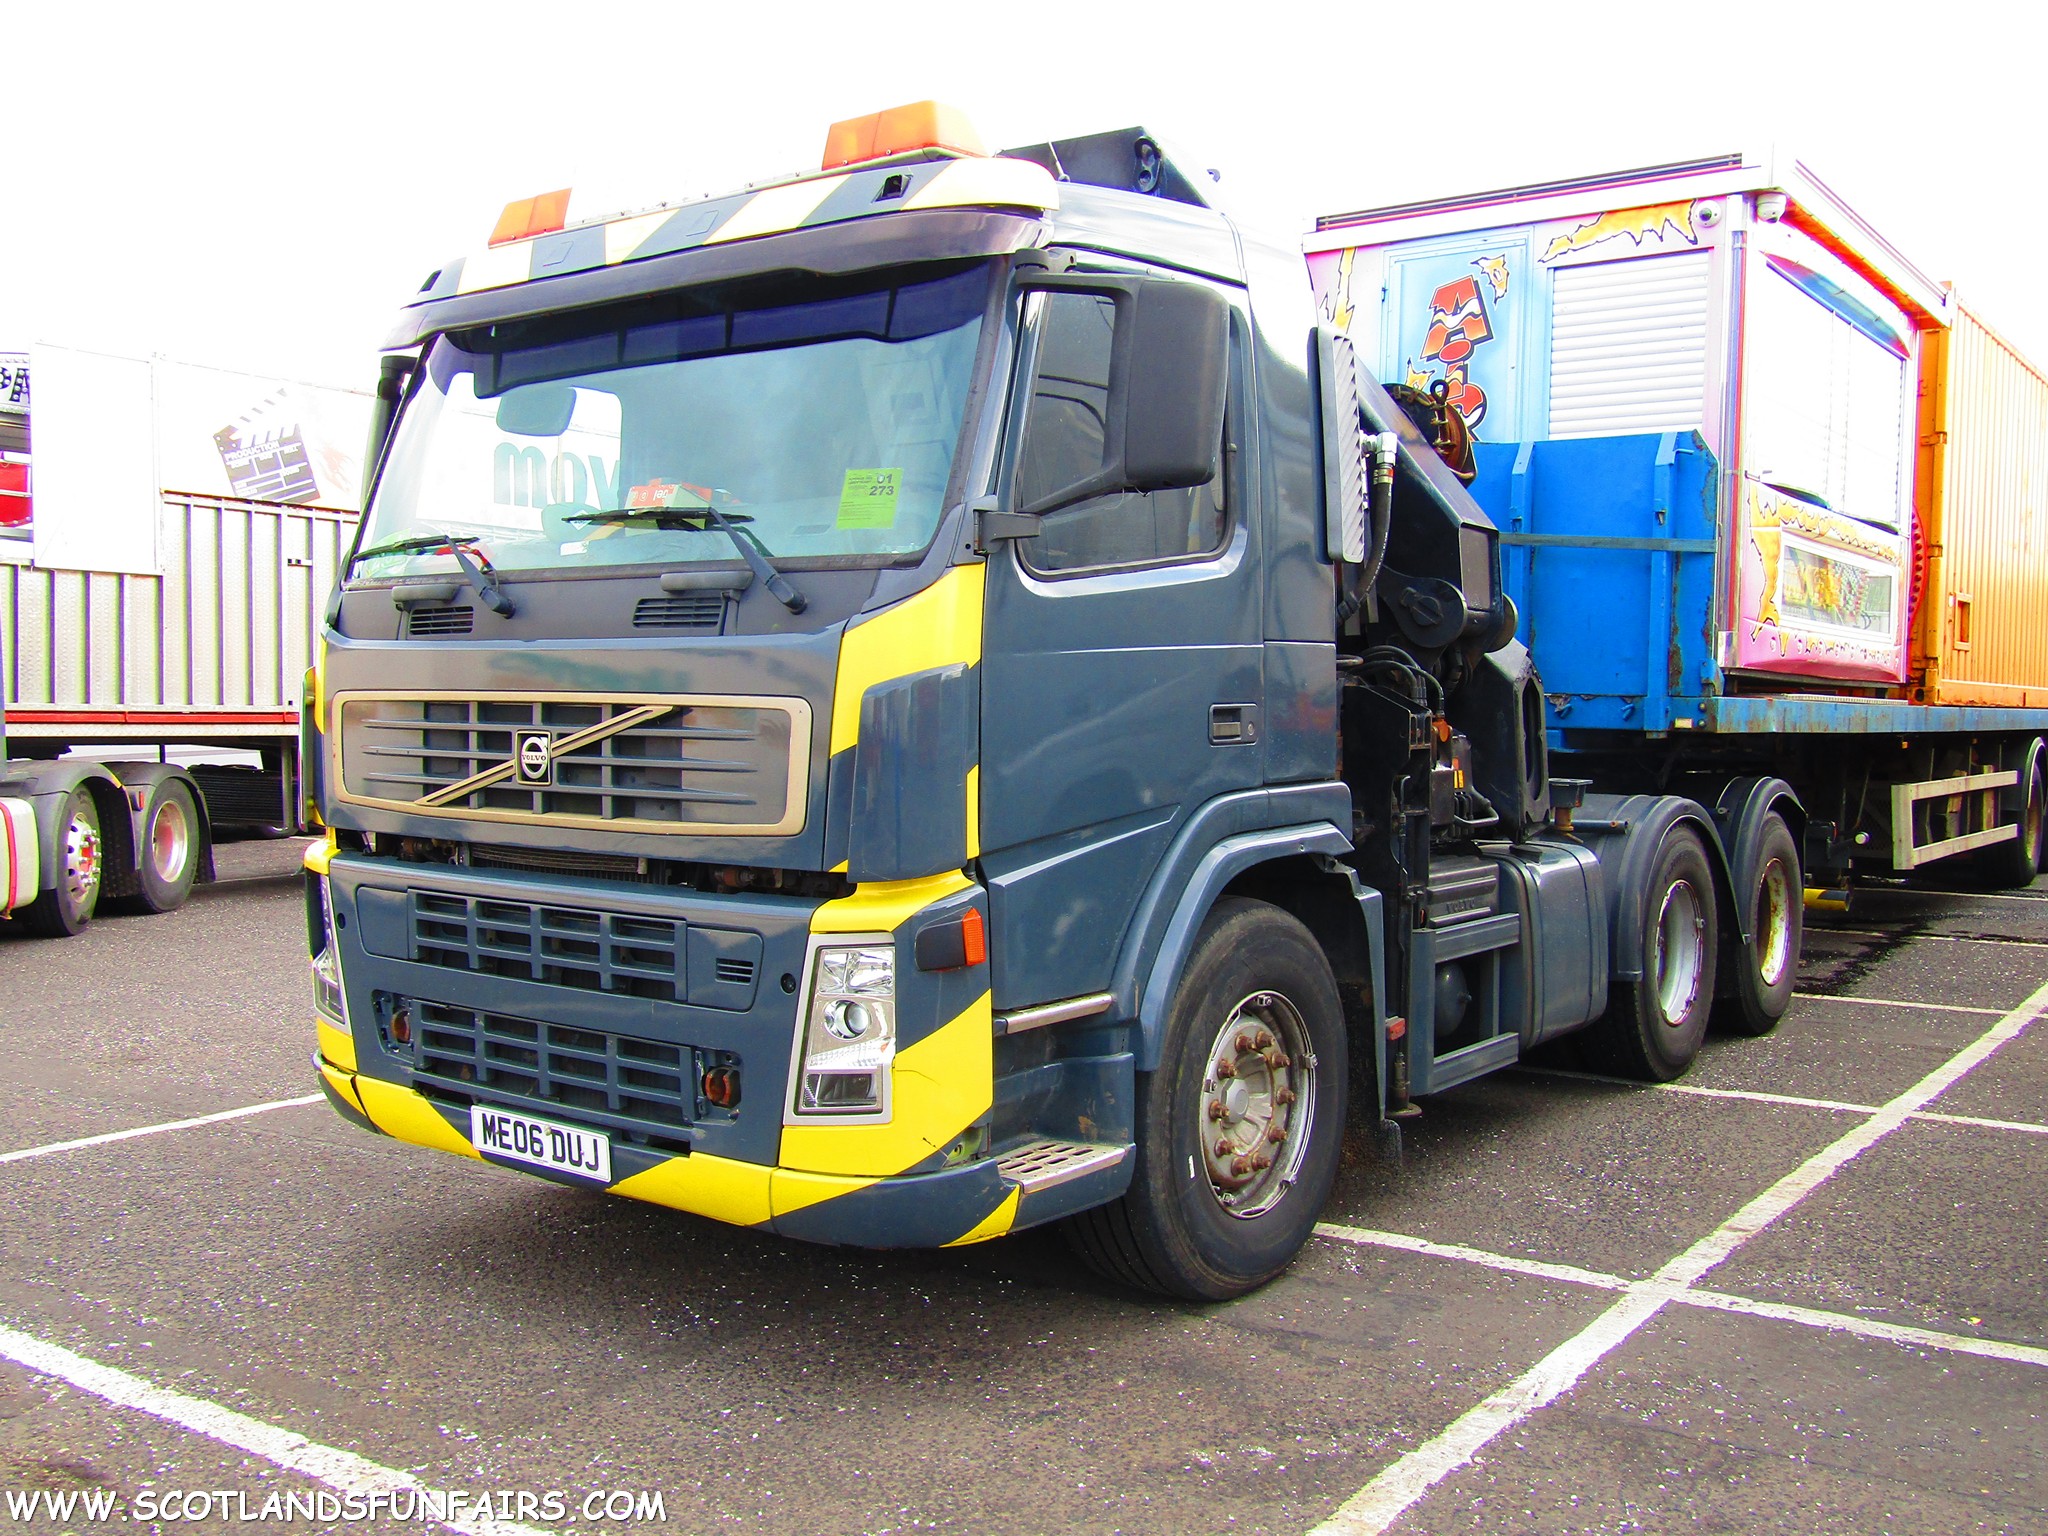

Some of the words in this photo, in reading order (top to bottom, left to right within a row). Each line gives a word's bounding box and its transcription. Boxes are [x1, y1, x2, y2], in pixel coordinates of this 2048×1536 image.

[223, 440, 280, 462] PRODUCTION
[869, 485, 895, 496] 273
[482, 1113, 544, 1157] ME06
[550, 1128, 600, 1172] DUJ
